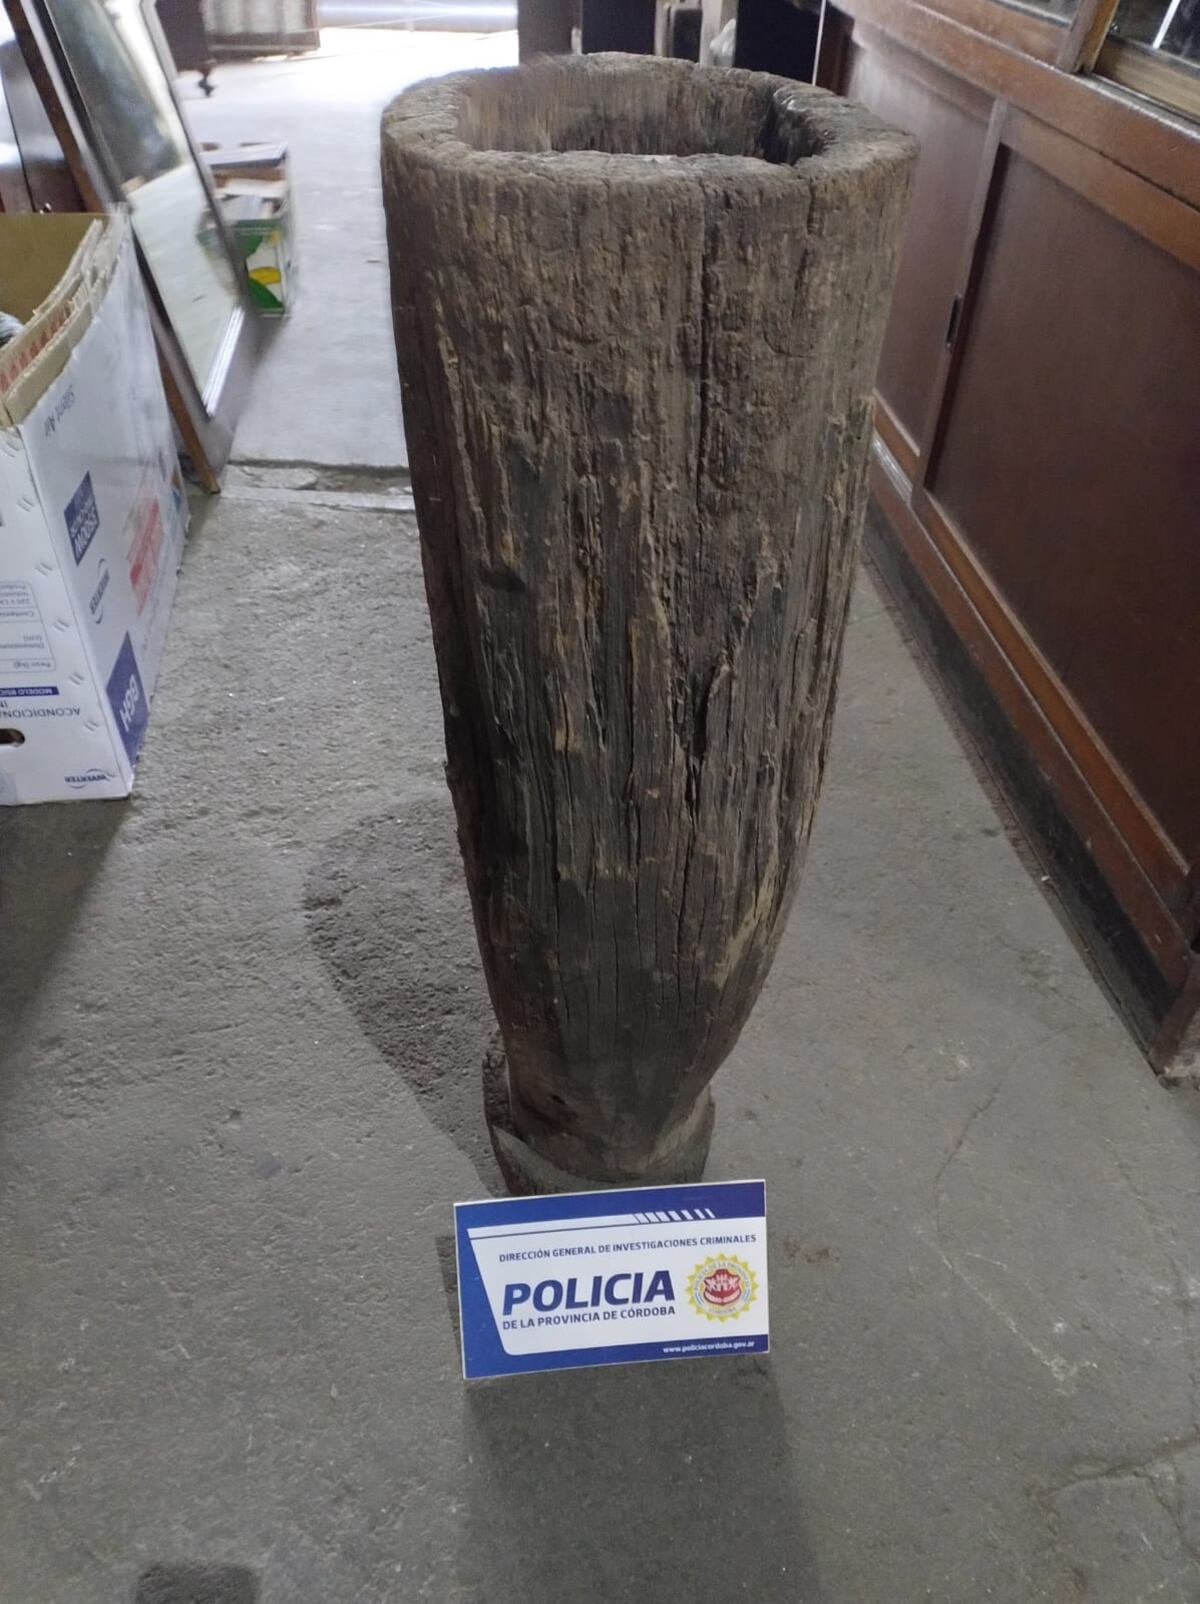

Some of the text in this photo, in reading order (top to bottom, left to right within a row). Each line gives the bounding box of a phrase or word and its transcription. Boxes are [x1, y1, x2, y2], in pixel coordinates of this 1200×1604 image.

[0, 707, 81, 719] ACONDICION
[119, 673, 141, 732] BGH
[64, 775, 107, 784] INVERTER
[499, 1234, 757, 1262] DIRECCIÓN GENERAL DE INVESTIGACIONES CRIMINALES
[502, 1270, 675, 1316] POLICIA
[503, 1306, 675, 1330] DE LA PROVINCIA DE CÓRDOBA
